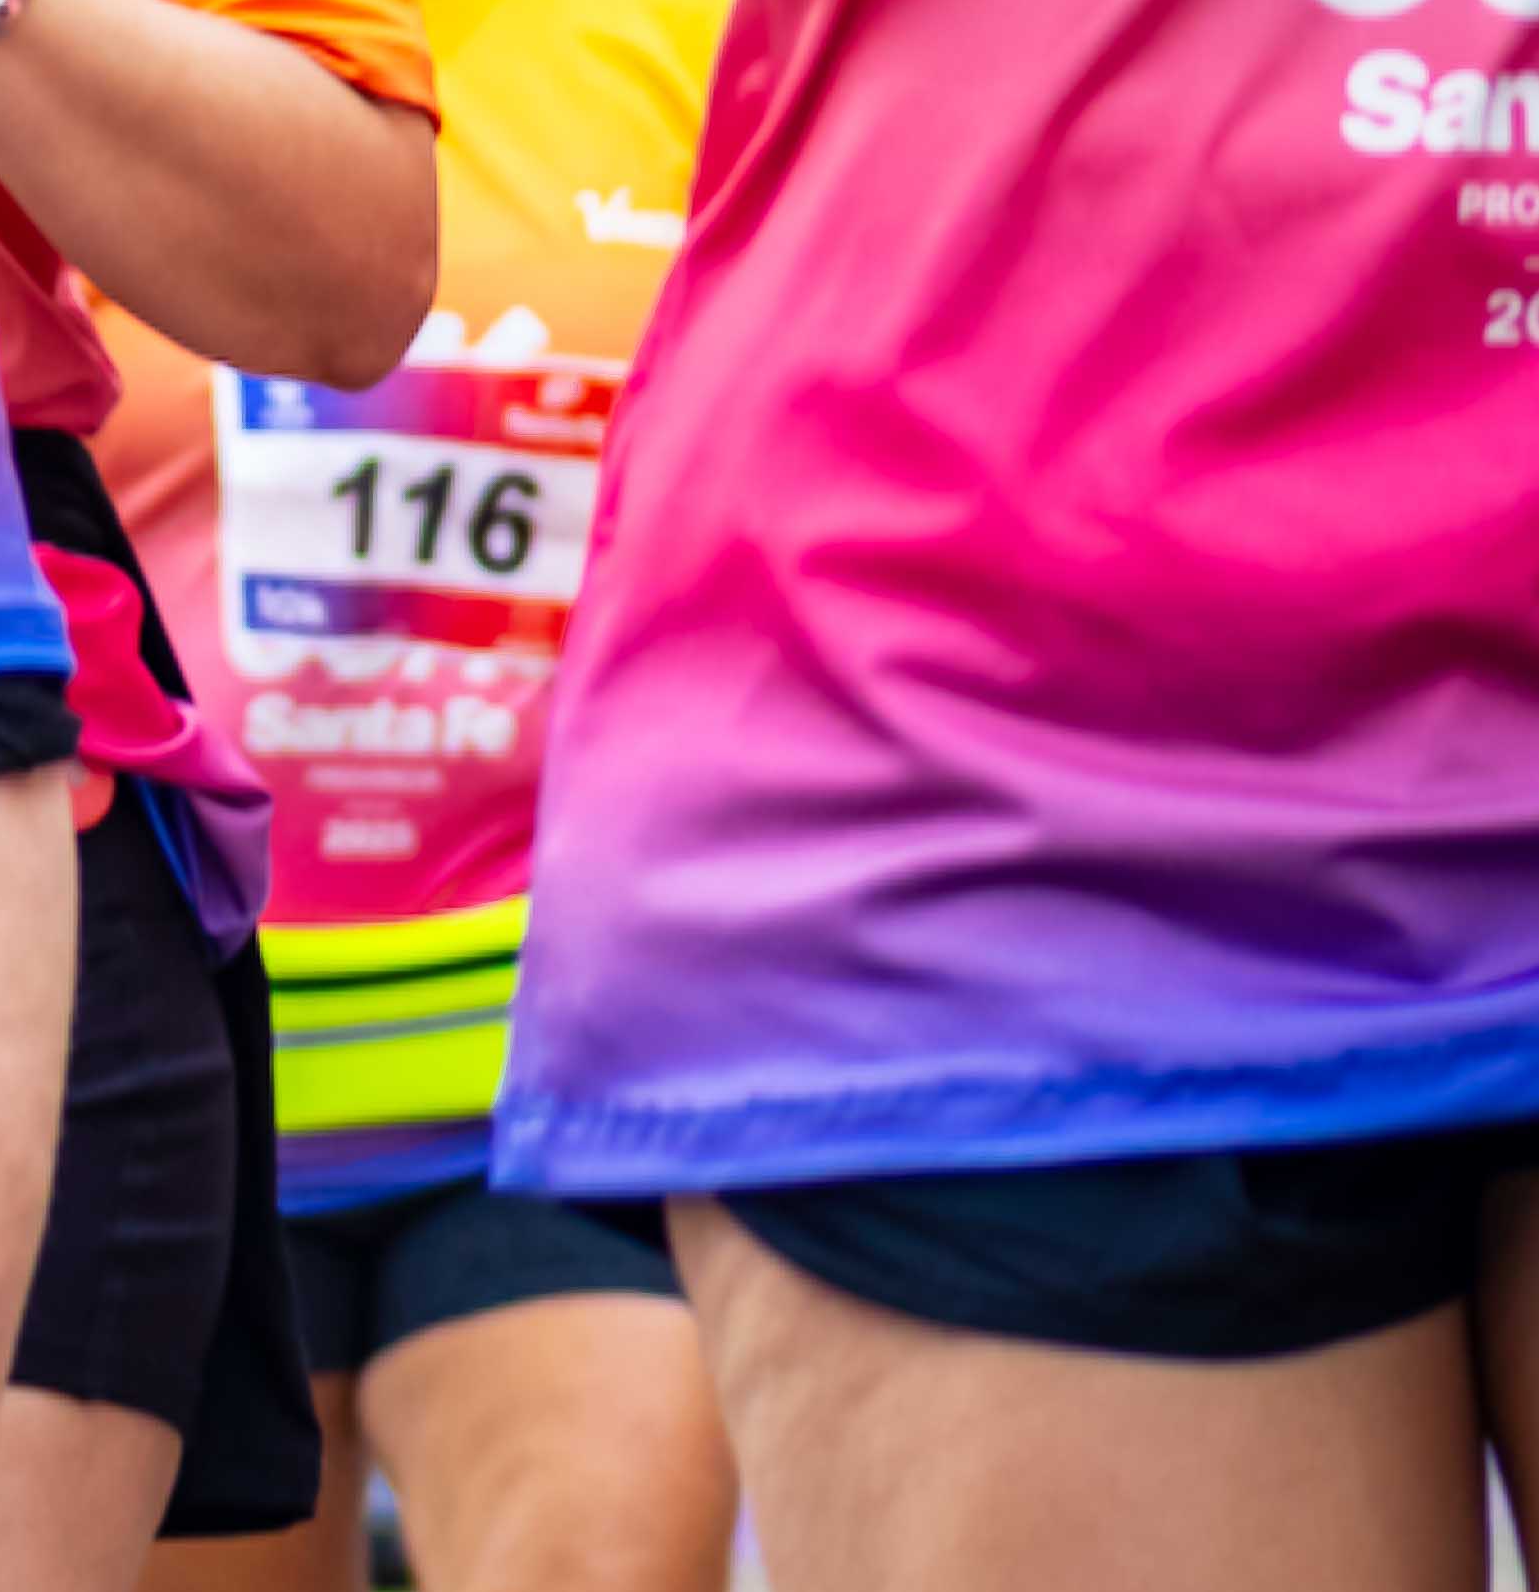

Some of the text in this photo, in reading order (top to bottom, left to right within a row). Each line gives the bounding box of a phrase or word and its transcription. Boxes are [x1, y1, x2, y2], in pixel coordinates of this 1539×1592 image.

[1340, 47, 1539, 158] San
[332, 454, 540, 574] 116
[243, 695, 517, 762] Santa Fe
